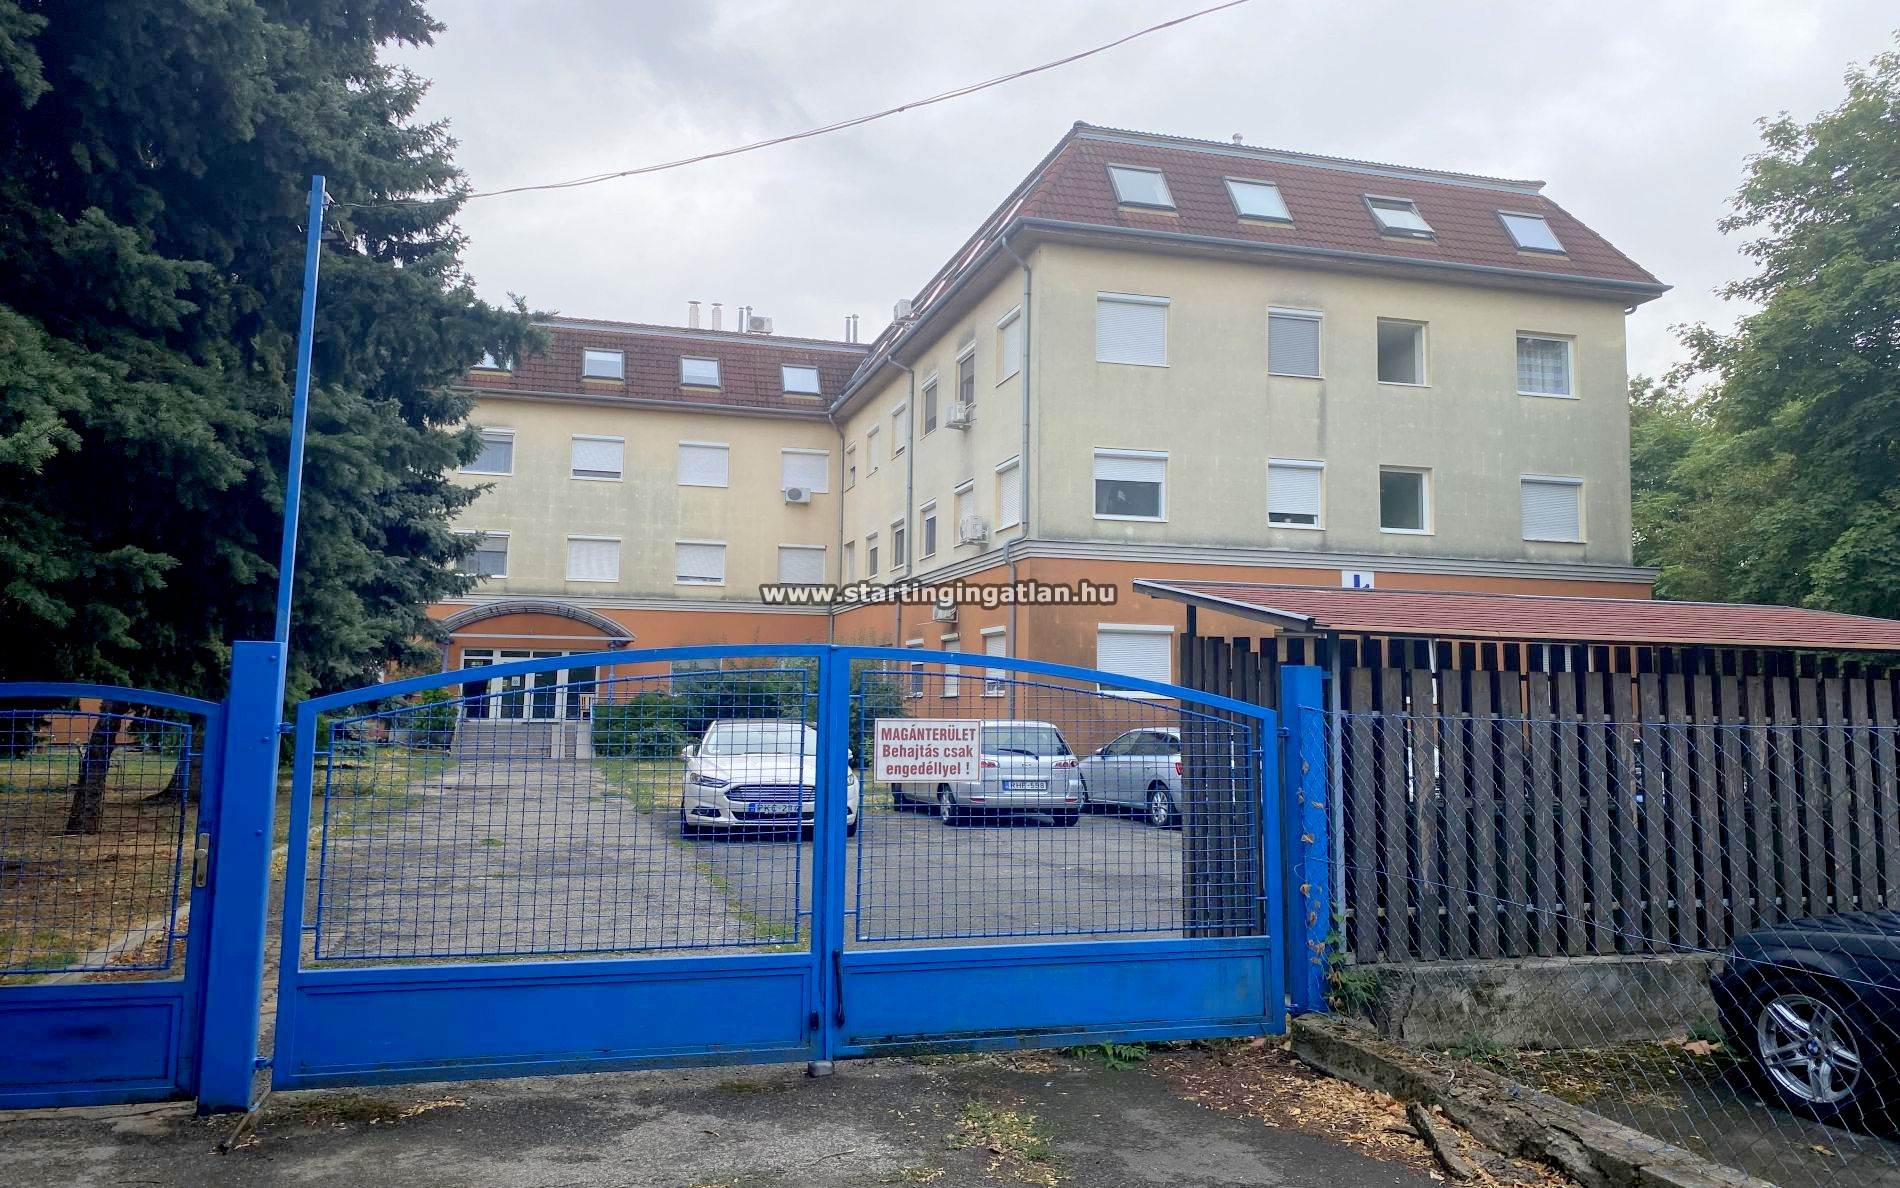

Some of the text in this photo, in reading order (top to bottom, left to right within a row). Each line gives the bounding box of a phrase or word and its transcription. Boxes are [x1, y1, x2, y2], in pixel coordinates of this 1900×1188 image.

[881, 724, 976, 741] MAGÁNTERÜLET
[882, 744, 973, 760] Behajtás csak
[886, 761, 961, 778] engedéllyel
